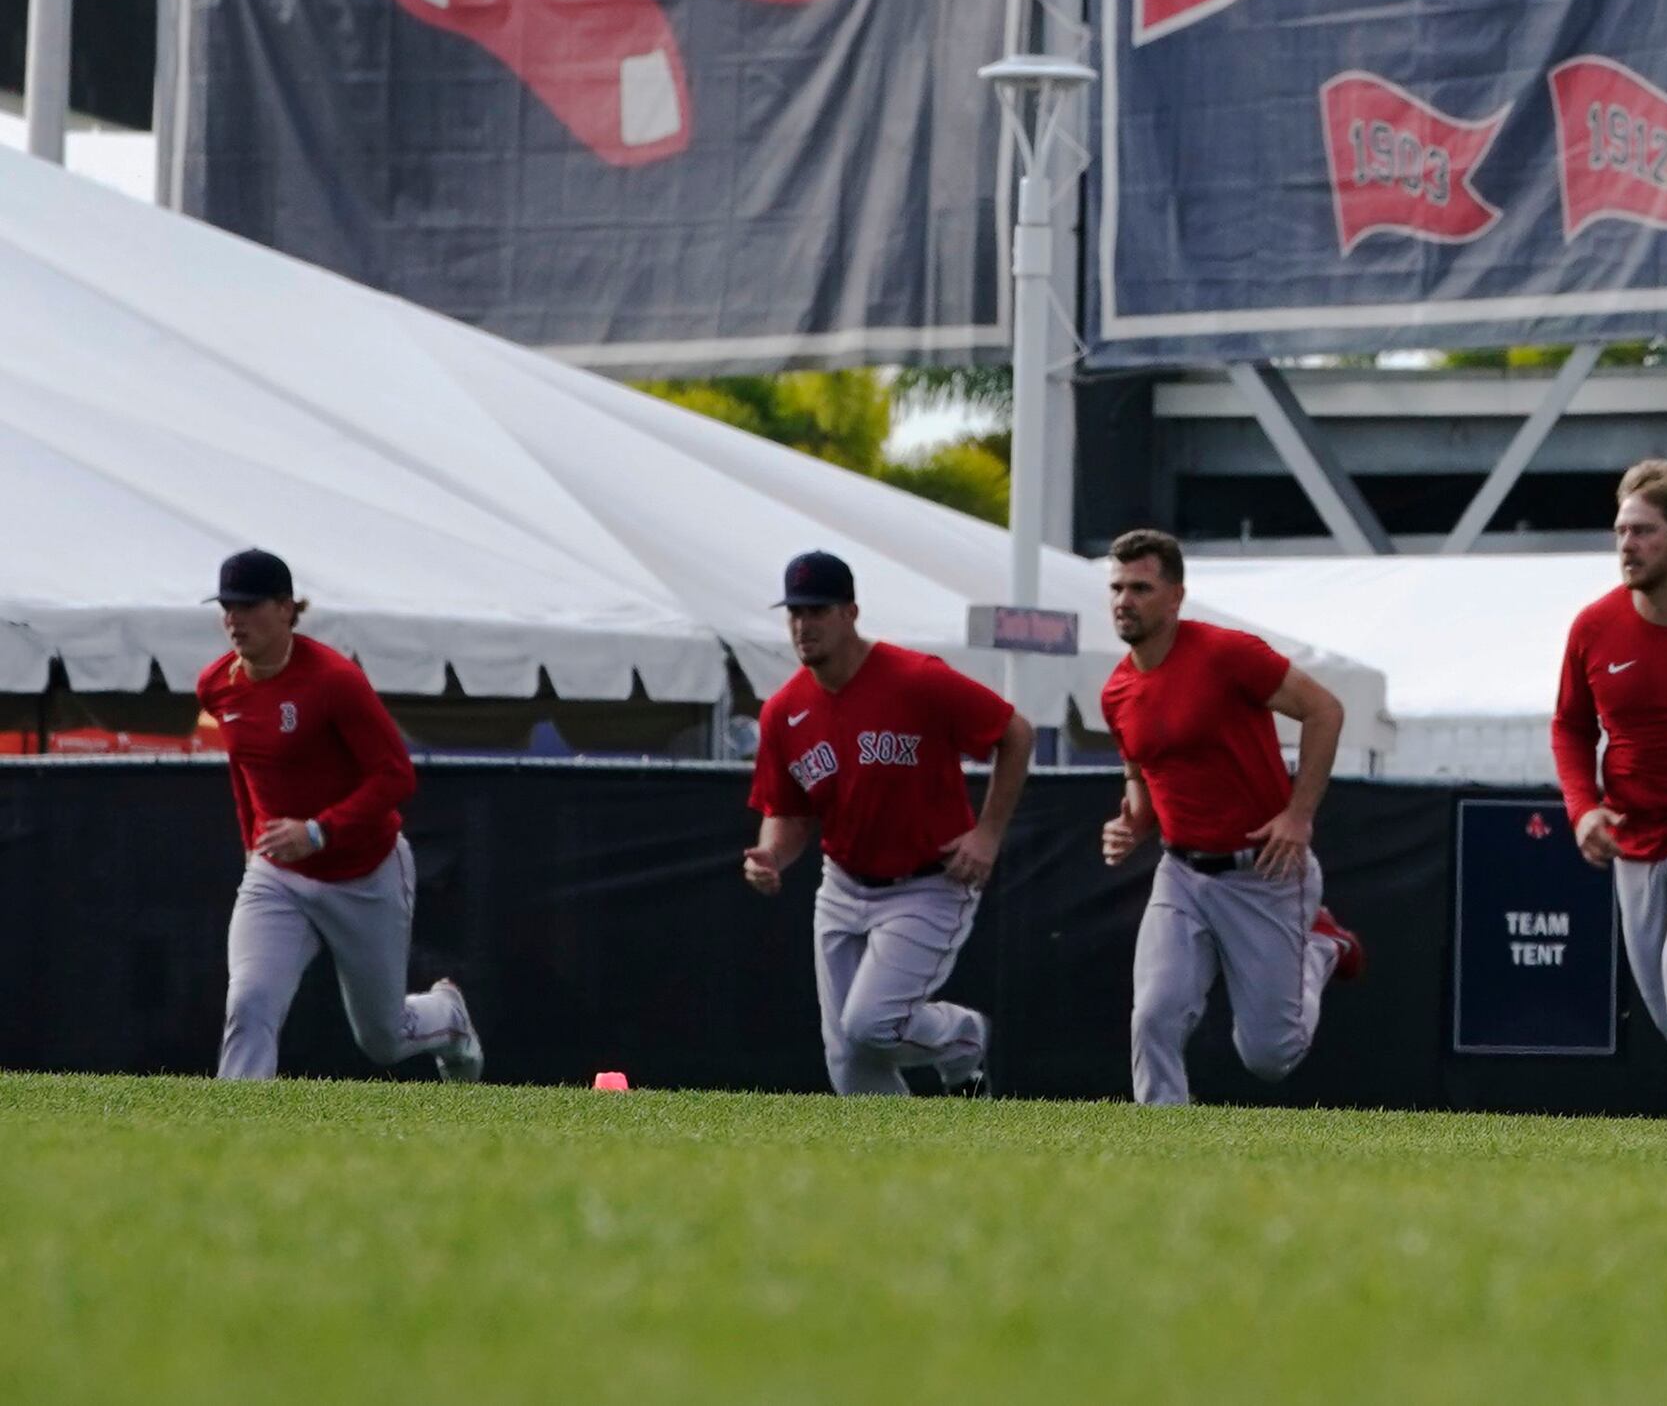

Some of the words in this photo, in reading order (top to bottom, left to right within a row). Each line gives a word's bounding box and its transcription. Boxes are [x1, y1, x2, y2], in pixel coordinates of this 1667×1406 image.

[857, 730, 922, 766] SOX
[1504, 911, 1570, 936] TEAM
[1509, 941, 1567, 966] TENT
